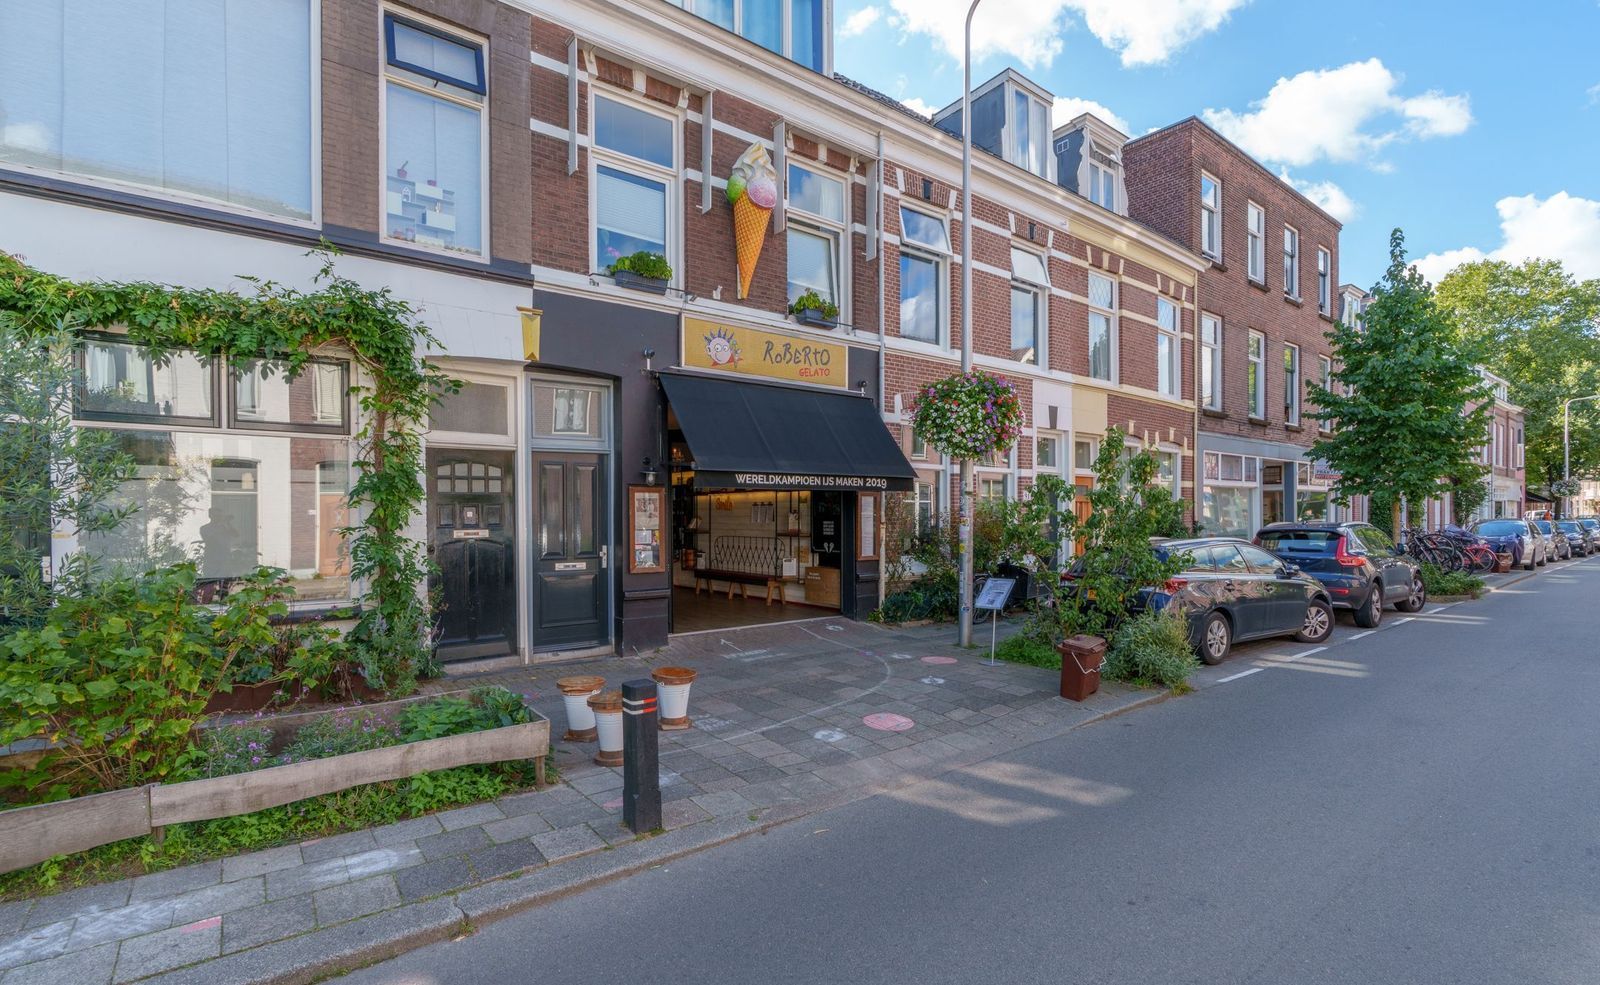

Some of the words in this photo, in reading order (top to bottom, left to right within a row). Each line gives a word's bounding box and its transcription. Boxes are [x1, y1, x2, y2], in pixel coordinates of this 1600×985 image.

[799, 367, 831, 377] GELATO
[735, 473, 821, 486] WERELDKAMPIOEN
[822, 476, 835, 487] IJS
[835, 476, 864, 487] MAKEN
[865, 478, 887, 489] 2019
